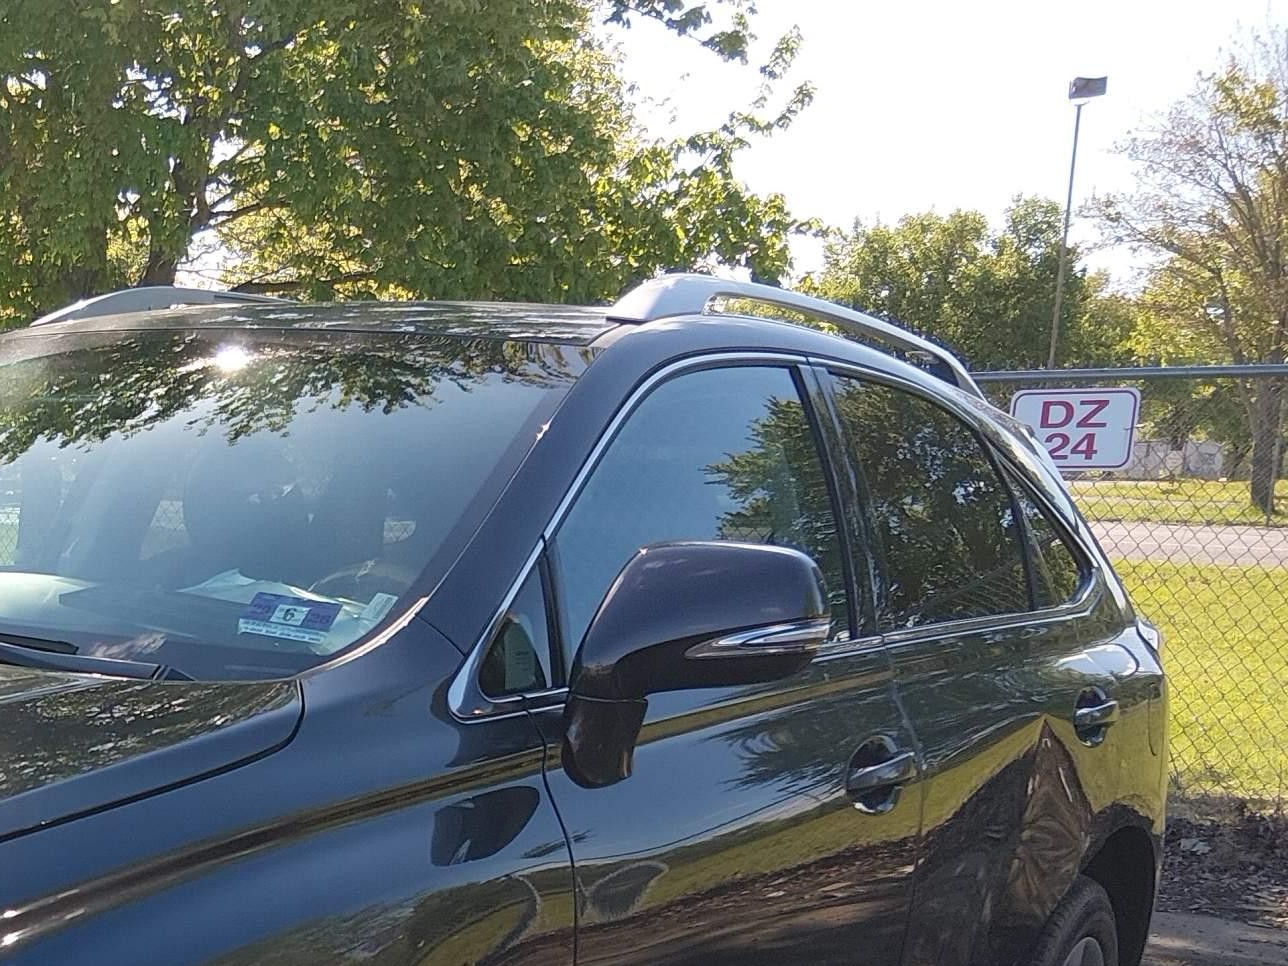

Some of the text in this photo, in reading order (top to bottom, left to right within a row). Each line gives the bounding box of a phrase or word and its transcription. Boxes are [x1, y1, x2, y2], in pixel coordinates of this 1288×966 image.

[1039, 400, 1110, 428] DZ
[1044, 432, 1098, 460] 24
[283, 608, 297, 621] 6
